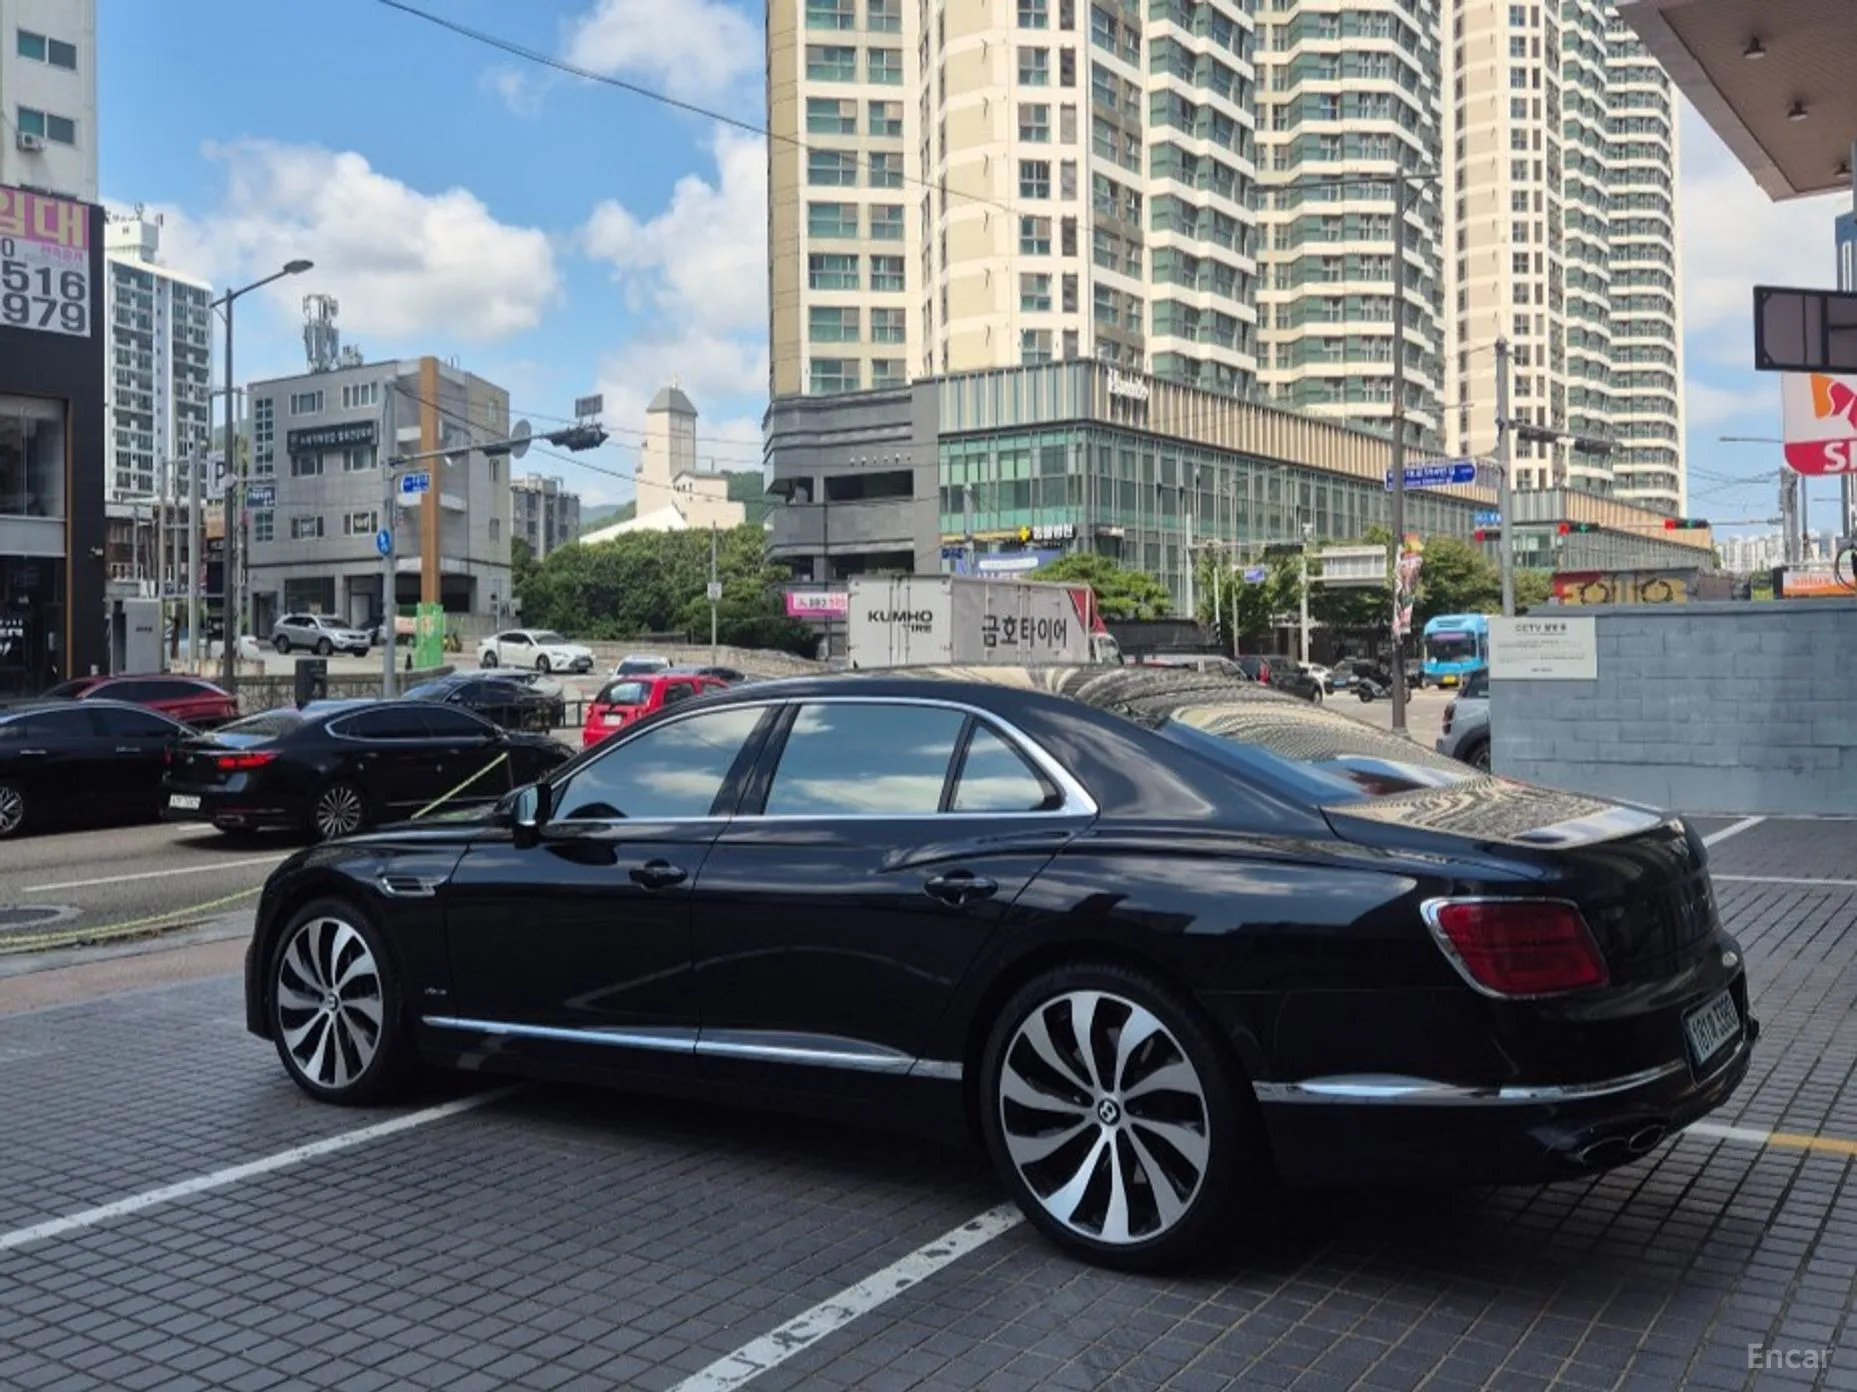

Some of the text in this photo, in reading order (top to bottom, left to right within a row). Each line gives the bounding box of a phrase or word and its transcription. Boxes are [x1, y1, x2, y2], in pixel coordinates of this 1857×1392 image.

[2, 260, 86, 302] 516
[2, 292, 86, 333] 979
[868, 610, 933, 623] KUMHO
[981, 614, 1067, 648] 금호타이어
